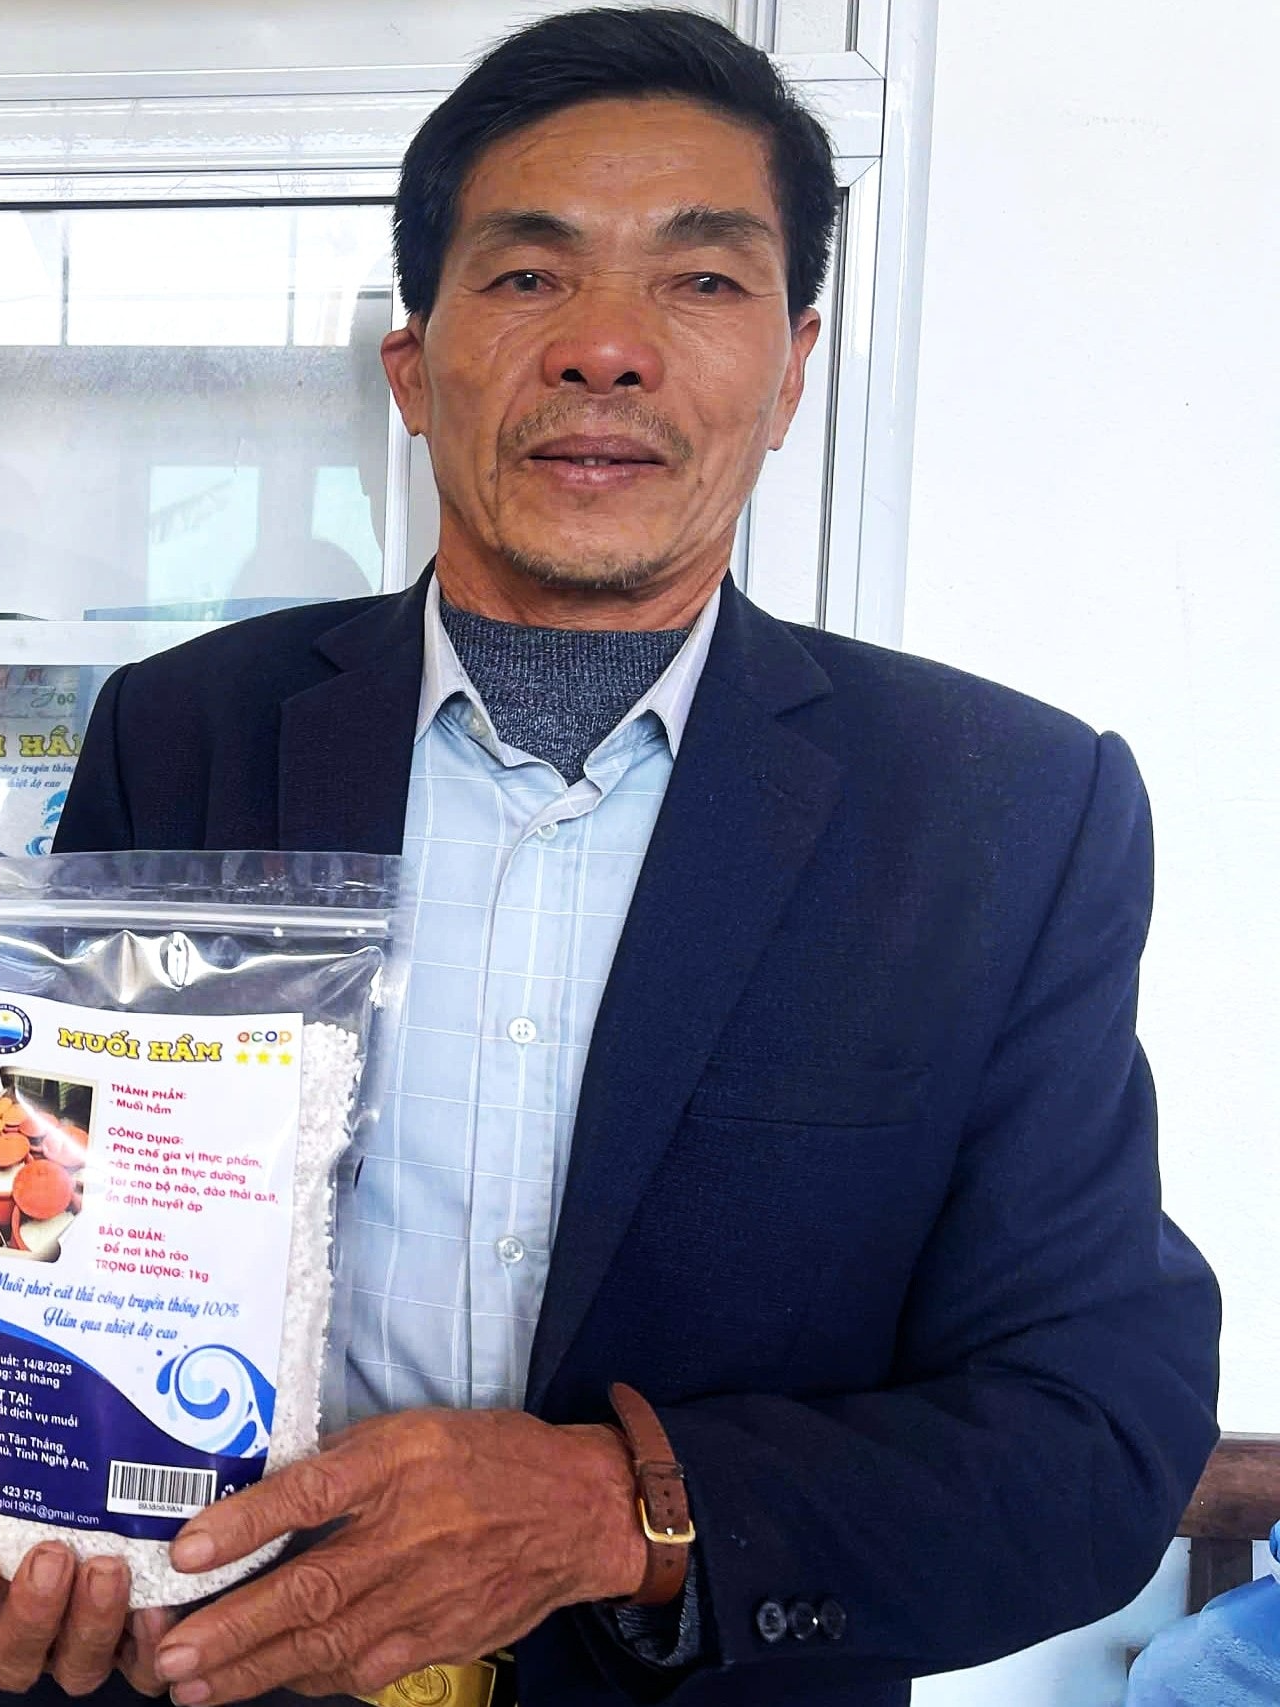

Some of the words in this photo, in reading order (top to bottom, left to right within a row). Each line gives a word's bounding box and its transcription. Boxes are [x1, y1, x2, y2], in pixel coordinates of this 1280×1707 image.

[57, 1027, 141, 1060] MUỐI
[148, 1033, 223, 1062] HẦM
[111, 1083, 149, 1098] THÀNH
[108, 1126, 144, 1140] CÔNG
[147, 1133, 184, 1147] DỤNG:
[113, 1143, 135, 1155] Pha
[138, 1148, 160, 1159] chế
[162, 1150, 181, 1162] gia
[185, 1150, 196, 1163] vị
[134, 1161, 159, 1174] món
[130, 1178, 152, 1189] cho
[123, 1193, 149, 1208] định
[151, 1195, 184, 1211] huyết
[187, 1201, 204, 1213] áp
[98, 1224, 124, 1238] BẢO
[127, 1227, 166, 1242] QUẢN:
[144, 1247, 167, 1259] khô
[169, 1250, 189, 1262] ráo
[96, 1258, 136, 1274] TRỌNG
[140, 1262, 185, 1279] LƯỢNG:
[188, 1269, 209, 1283] 1kg
[24, 1279, 53, 1298] phơi
[97, 1290, 125, 1309] công
[128, 1292, 165, 1313] truyền
[168, 1296, 200, 1318] thống
[202, 1300, 240, 1318] 100%
[80, 1319, 102, 1335] qua
[104, 1317, 135, 1338] nhiệt
[137, 1321, 154, 1341] độ
[156, 1327, 178, 1340] cao
[22, 1357, 73, 1376] 14/8/2025
[14, 1370, 27, 1382] 36
[29, 1372, 60, 1389] tháng
[8, 1390, 33, 1408] TẠI:
[10, 1407, 33, 1421] dịch
[35, 1412, 48, 1425] vụ
[51, 1412, 79, 1428] muối
[8, 1432, 27, 1447] Tân
[41, 1451, 69, 1469] Nghệ
[71, 1457, 90, 1471] An,
[2, 1485, 21, 1499] 423
[23, 1489, 43, 1502] 575
